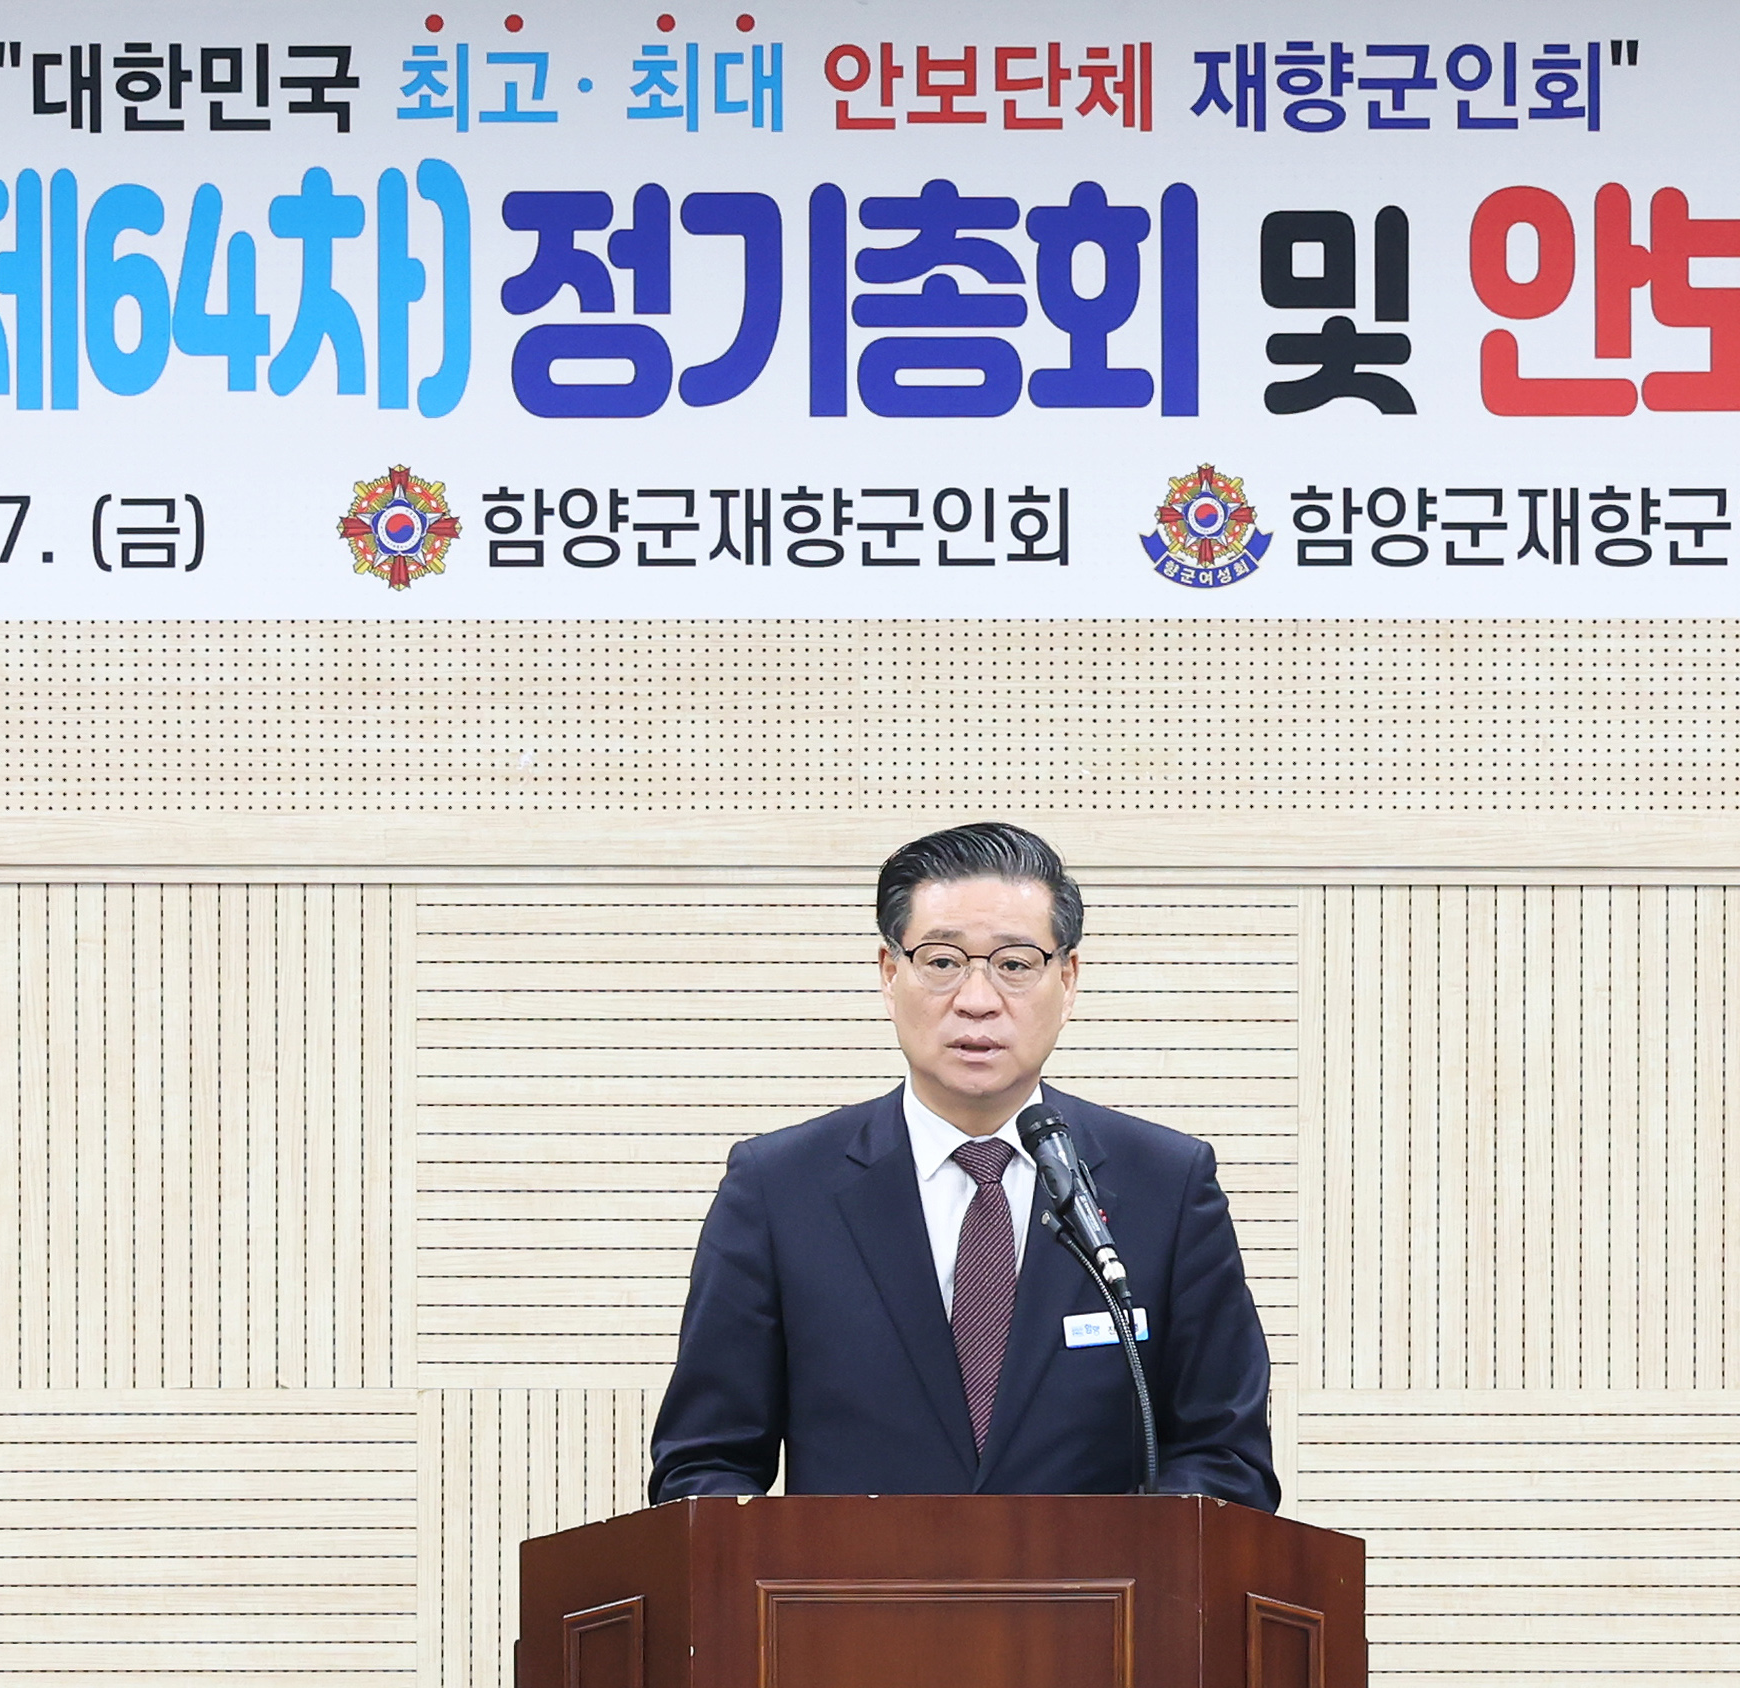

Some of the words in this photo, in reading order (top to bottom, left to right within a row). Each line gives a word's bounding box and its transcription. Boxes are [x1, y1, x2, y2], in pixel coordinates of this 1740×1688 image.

[823, 41, 1153, 133] 안보단체
[1189, 40, 1639, 134] 재향군인회"
[500, 178, 1200, 419] 정기총회
[1259, 204, 1418, 416] 및
[91, 493, 205, 573] (금)
[481, 484, 1070, 569] 함양군재향군인회
[1162, 559, 1251, 586] 향군여성회
